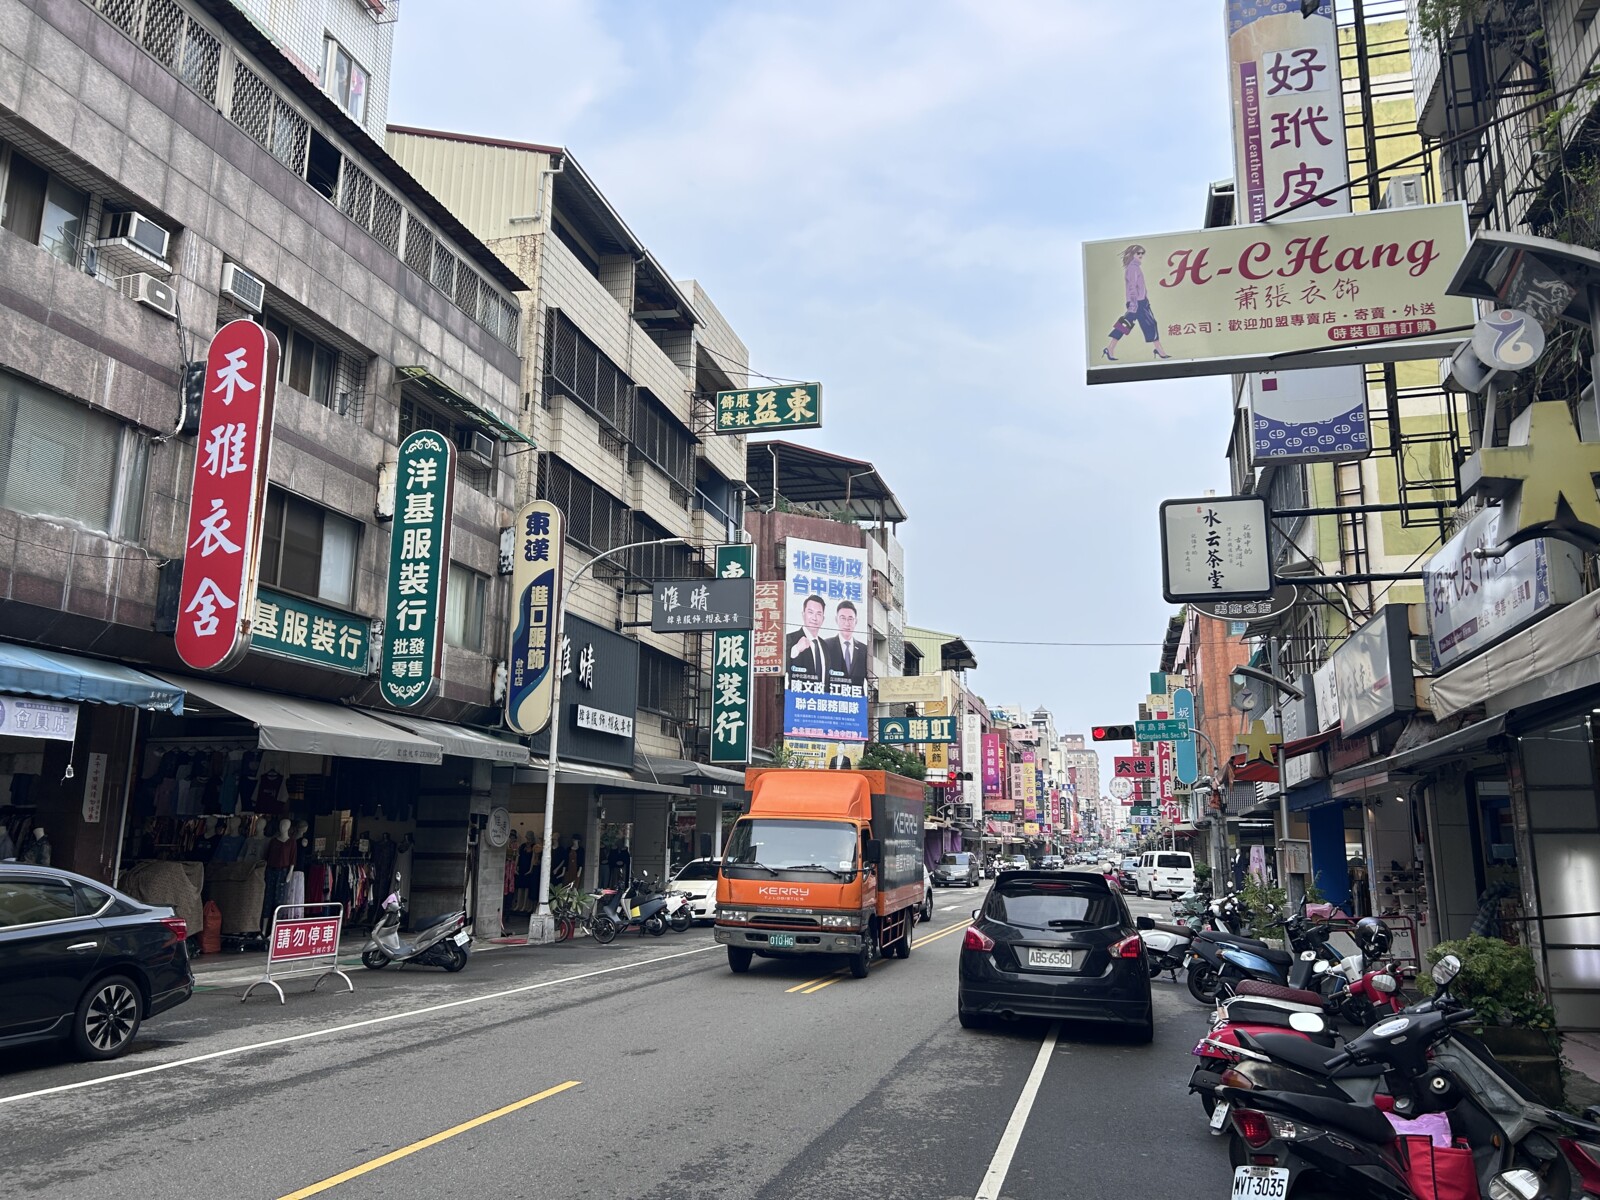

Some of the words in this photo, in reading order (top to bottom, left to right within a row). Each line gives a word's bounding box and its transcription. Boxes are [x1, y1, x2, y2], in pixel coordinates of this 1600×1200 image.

[1248, 135, 1261, 185] Leather
[1332, 320, 1433, 340] 時裝團體訂購
[184, 347, 256, 638] 禾雅衣舍
[396, 458, 437, 633] 洋基服裝行
[524, 511, 550, 562] 東漢
[793, 550, 863, 580] 北區勤政
[527, 585, 549, 670] 進口服飾
[393, 637, 424, 655] 批發
[391, 659, 424, 678] 零售
[514, 658, 524, 686] 台中店
[791, 680, 825, 695] 陳文政
[795, 698, 860, 714] 聯合服務團隊
[15, 710, 68, 733] 會員店
[1137, 722, 1187, 731] 青島路一段
[894, 811, 918, 835] KERRY
[759, 887, 810, 896] KERRY
[277, 925, 335, 949] 請勿停車
